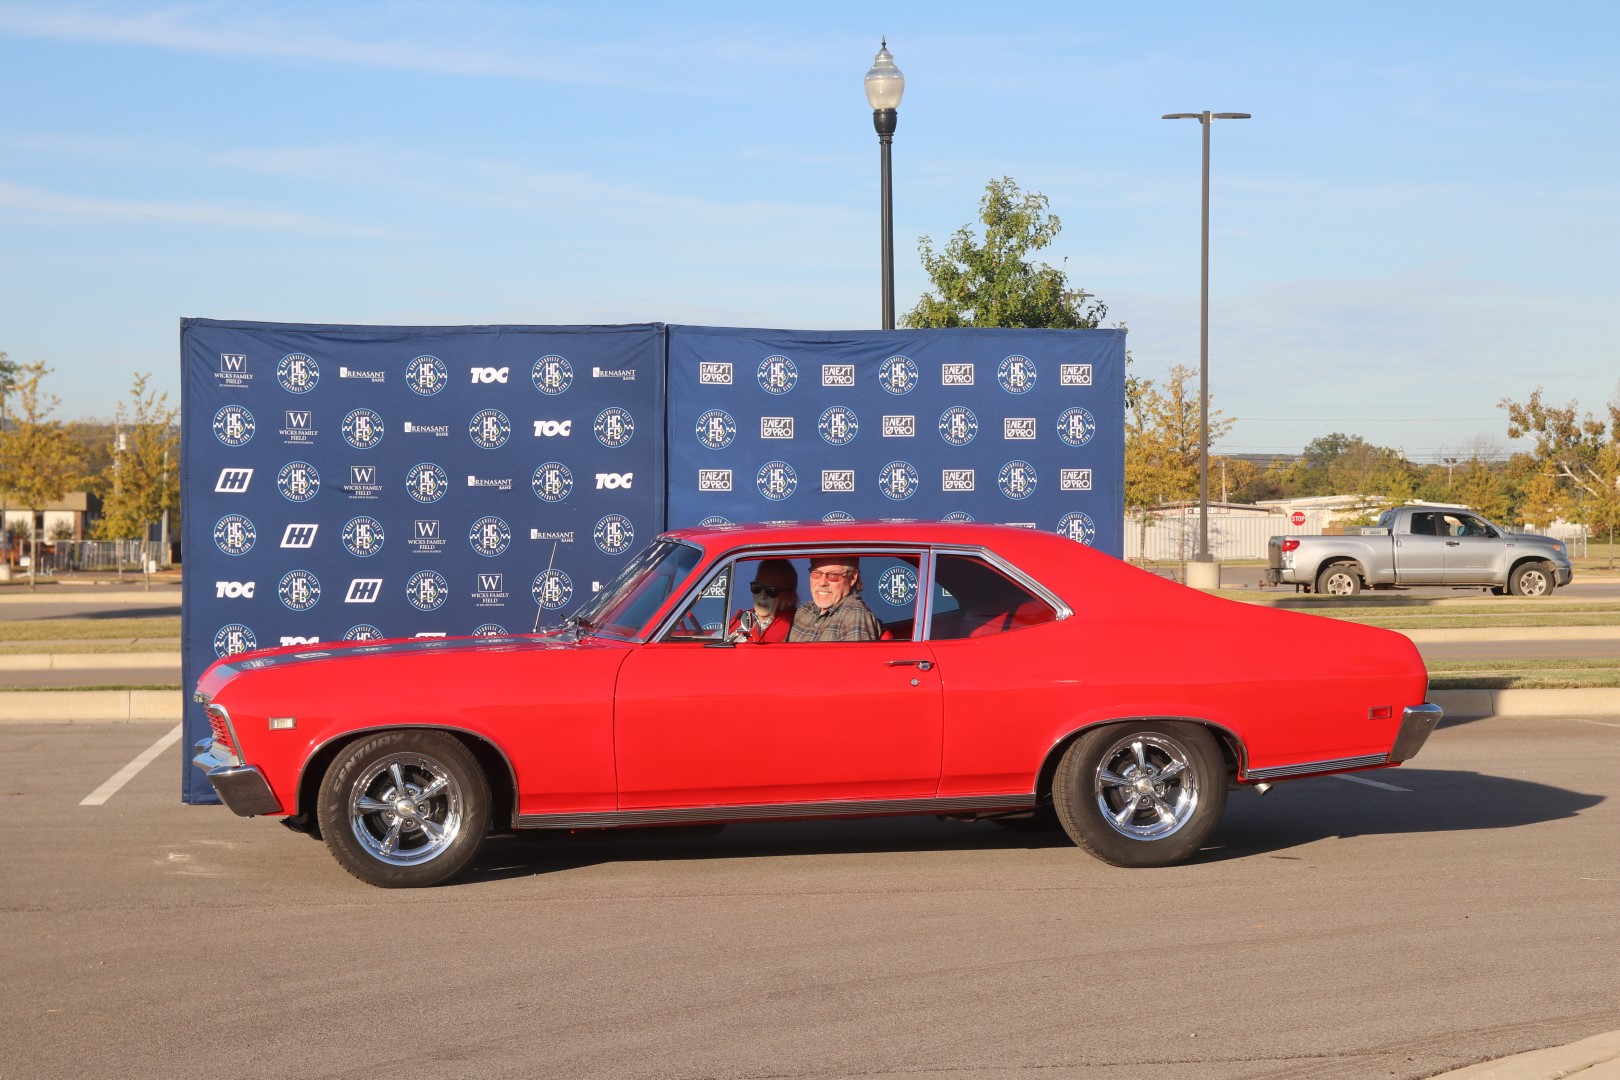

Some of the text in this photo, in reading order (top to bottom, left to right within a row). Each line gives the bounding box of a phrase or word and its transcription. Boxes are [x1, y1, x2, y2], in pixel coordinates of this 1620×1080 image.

[223, 355, 243, 370] W
[706, 364, 729, 373] NEXT
[948, 366, 971, 374] NEXT
[470, 367, 509, 383] TOC
[711, 374, 730, 382] PRO
[953, 375, 972, 383] PRO
[289, 413, 308, 428] W
[767, 419, 790, 428] NEXT
[889, 418, 912, 426] NEXT
[534, 420, 572, 436] TOC
[772, 428, 791, 436] PRO
[894, 426, 913, 434] PRO
[353, 468, 373, 482] W
[705, 472, 729, 480] NEXT
[948, 472, 971, 480] NEXT
[595, 473, 633, 489] TOC
[711, 480, 730, 489] PRO
[954, 481, 972, 489] PRO
[417, 522, 437, 538] W
[480, 576, 500, 591] W
[216, 581, 255, 598] TOC
